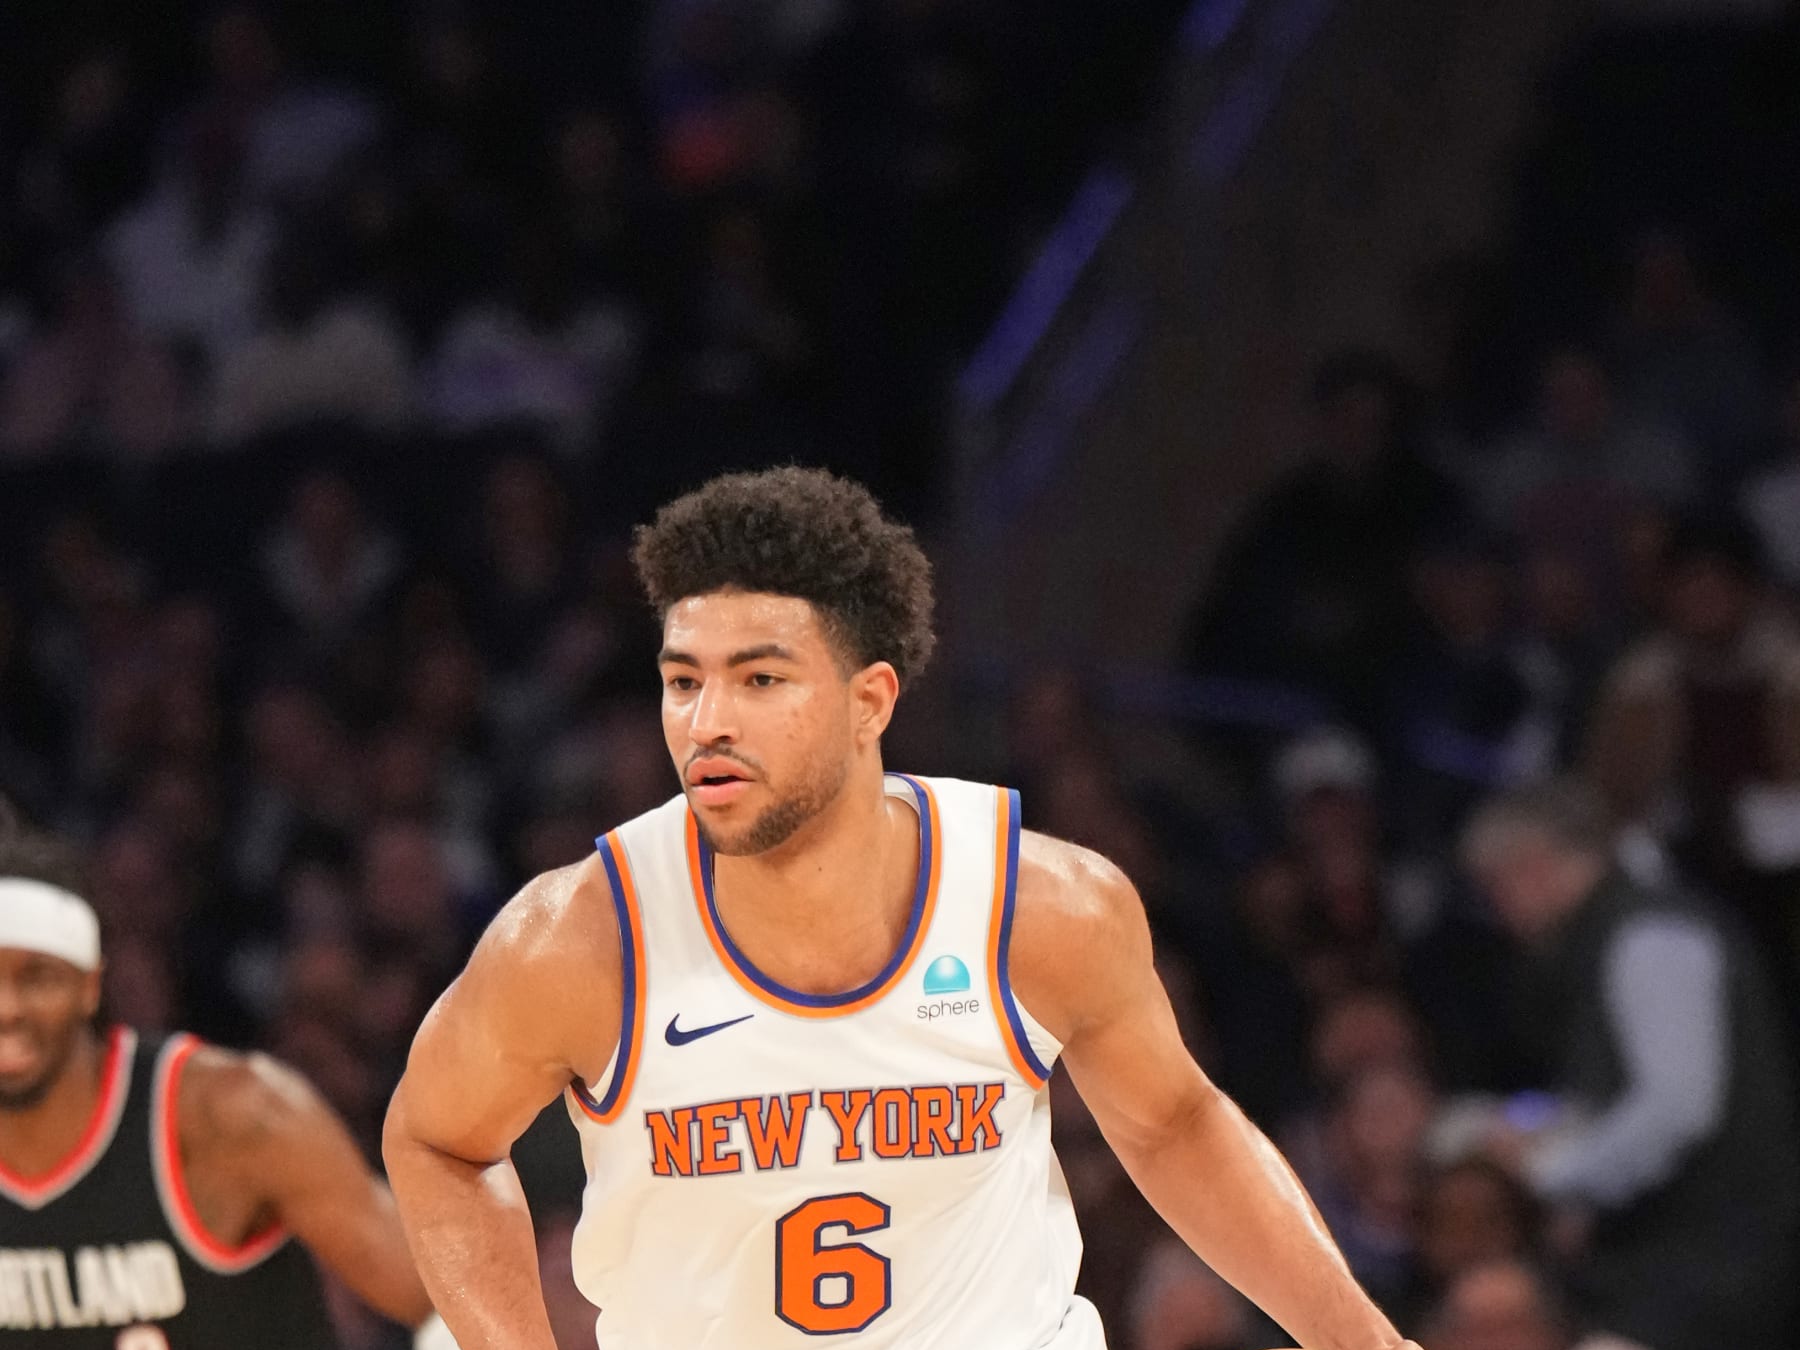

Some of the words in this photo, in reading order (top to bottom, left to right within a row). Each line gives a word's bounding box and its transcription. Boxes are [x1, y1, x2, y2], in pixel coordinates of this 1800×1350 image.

[917, 999, 980, 1021] sphere
[645, 1091, 813, 1177] NEW
[820, 1082, 1005, 1163] YORK
[775, 1191, 891, 1335] 6
